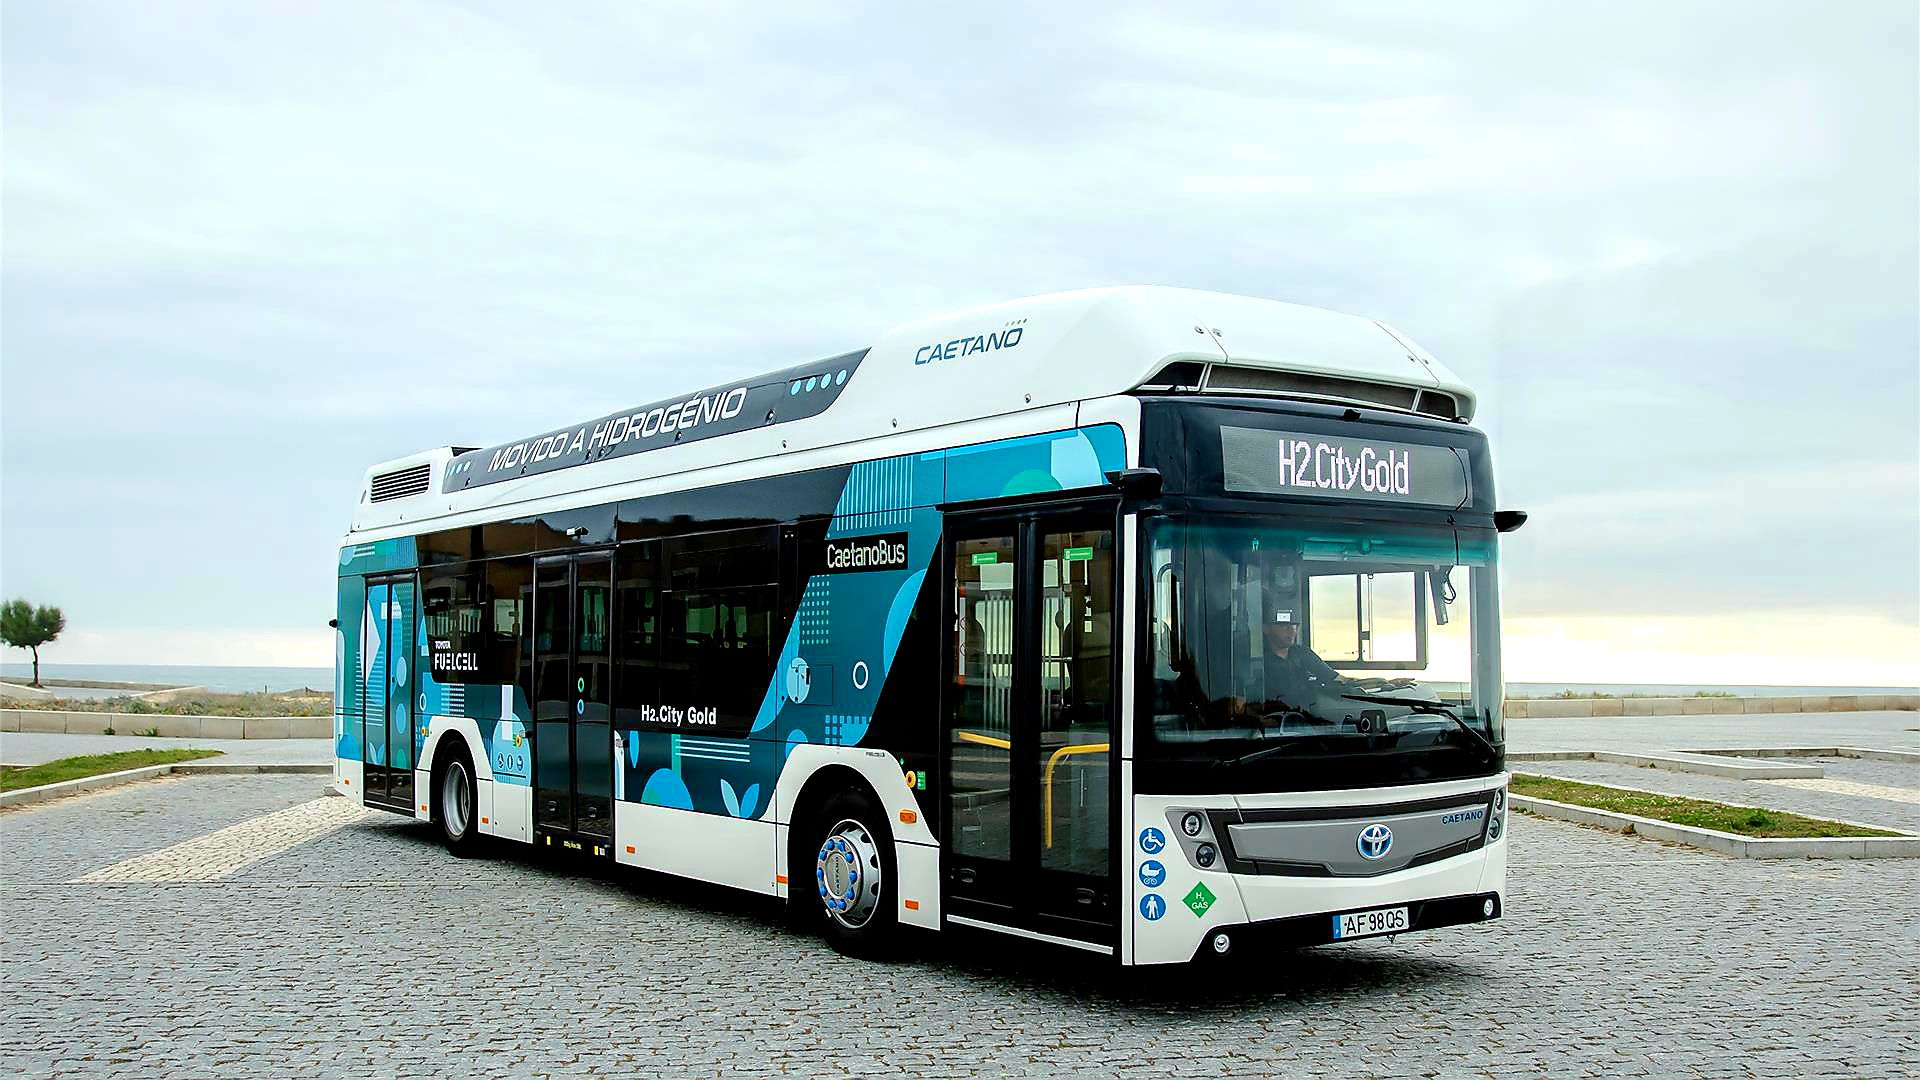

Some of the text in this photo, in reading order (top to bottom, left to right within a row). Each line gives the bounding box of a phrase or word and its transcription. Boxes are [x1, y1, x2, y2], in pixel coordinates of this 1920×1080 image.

[915, 327, 1023, 365] CAETANO
[488, 387, 747, 473] MOVIDO A HIDROGÉNIO
[827, 539, 905, 569] CaetanoBus
[434, 652, 479, 671] FUELCELL
[641, 704, 717, 727] H2.City Gold
[1441, 810, 1483, 825] CAETANO
[1191, 901, 1208, 910] GAS
